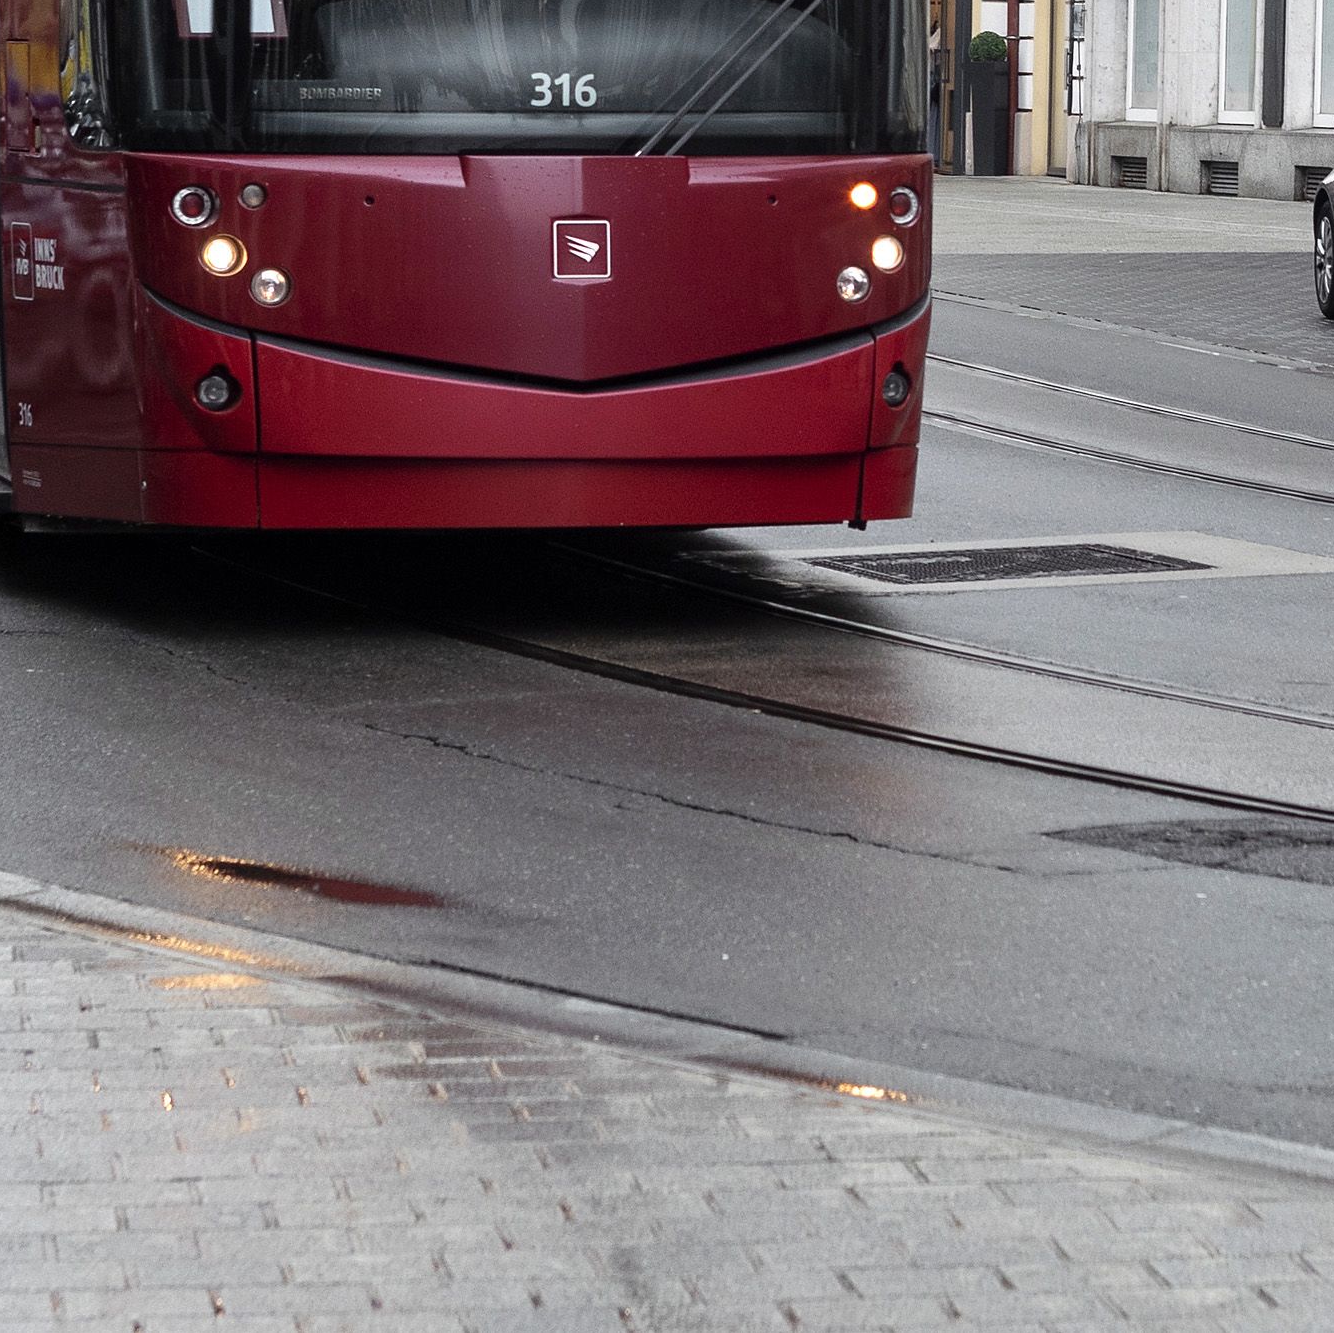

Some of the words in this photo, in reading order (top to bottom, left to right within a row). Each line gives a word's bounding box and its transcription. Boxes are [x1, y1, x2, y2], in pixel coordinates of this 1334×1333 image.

[299, 86, 382, 101] BOMBARDIER
[530, 72, 597, 108] 316
[35, 264, 65, 291] BRUCK
[18, 401, 33, 427] 316
